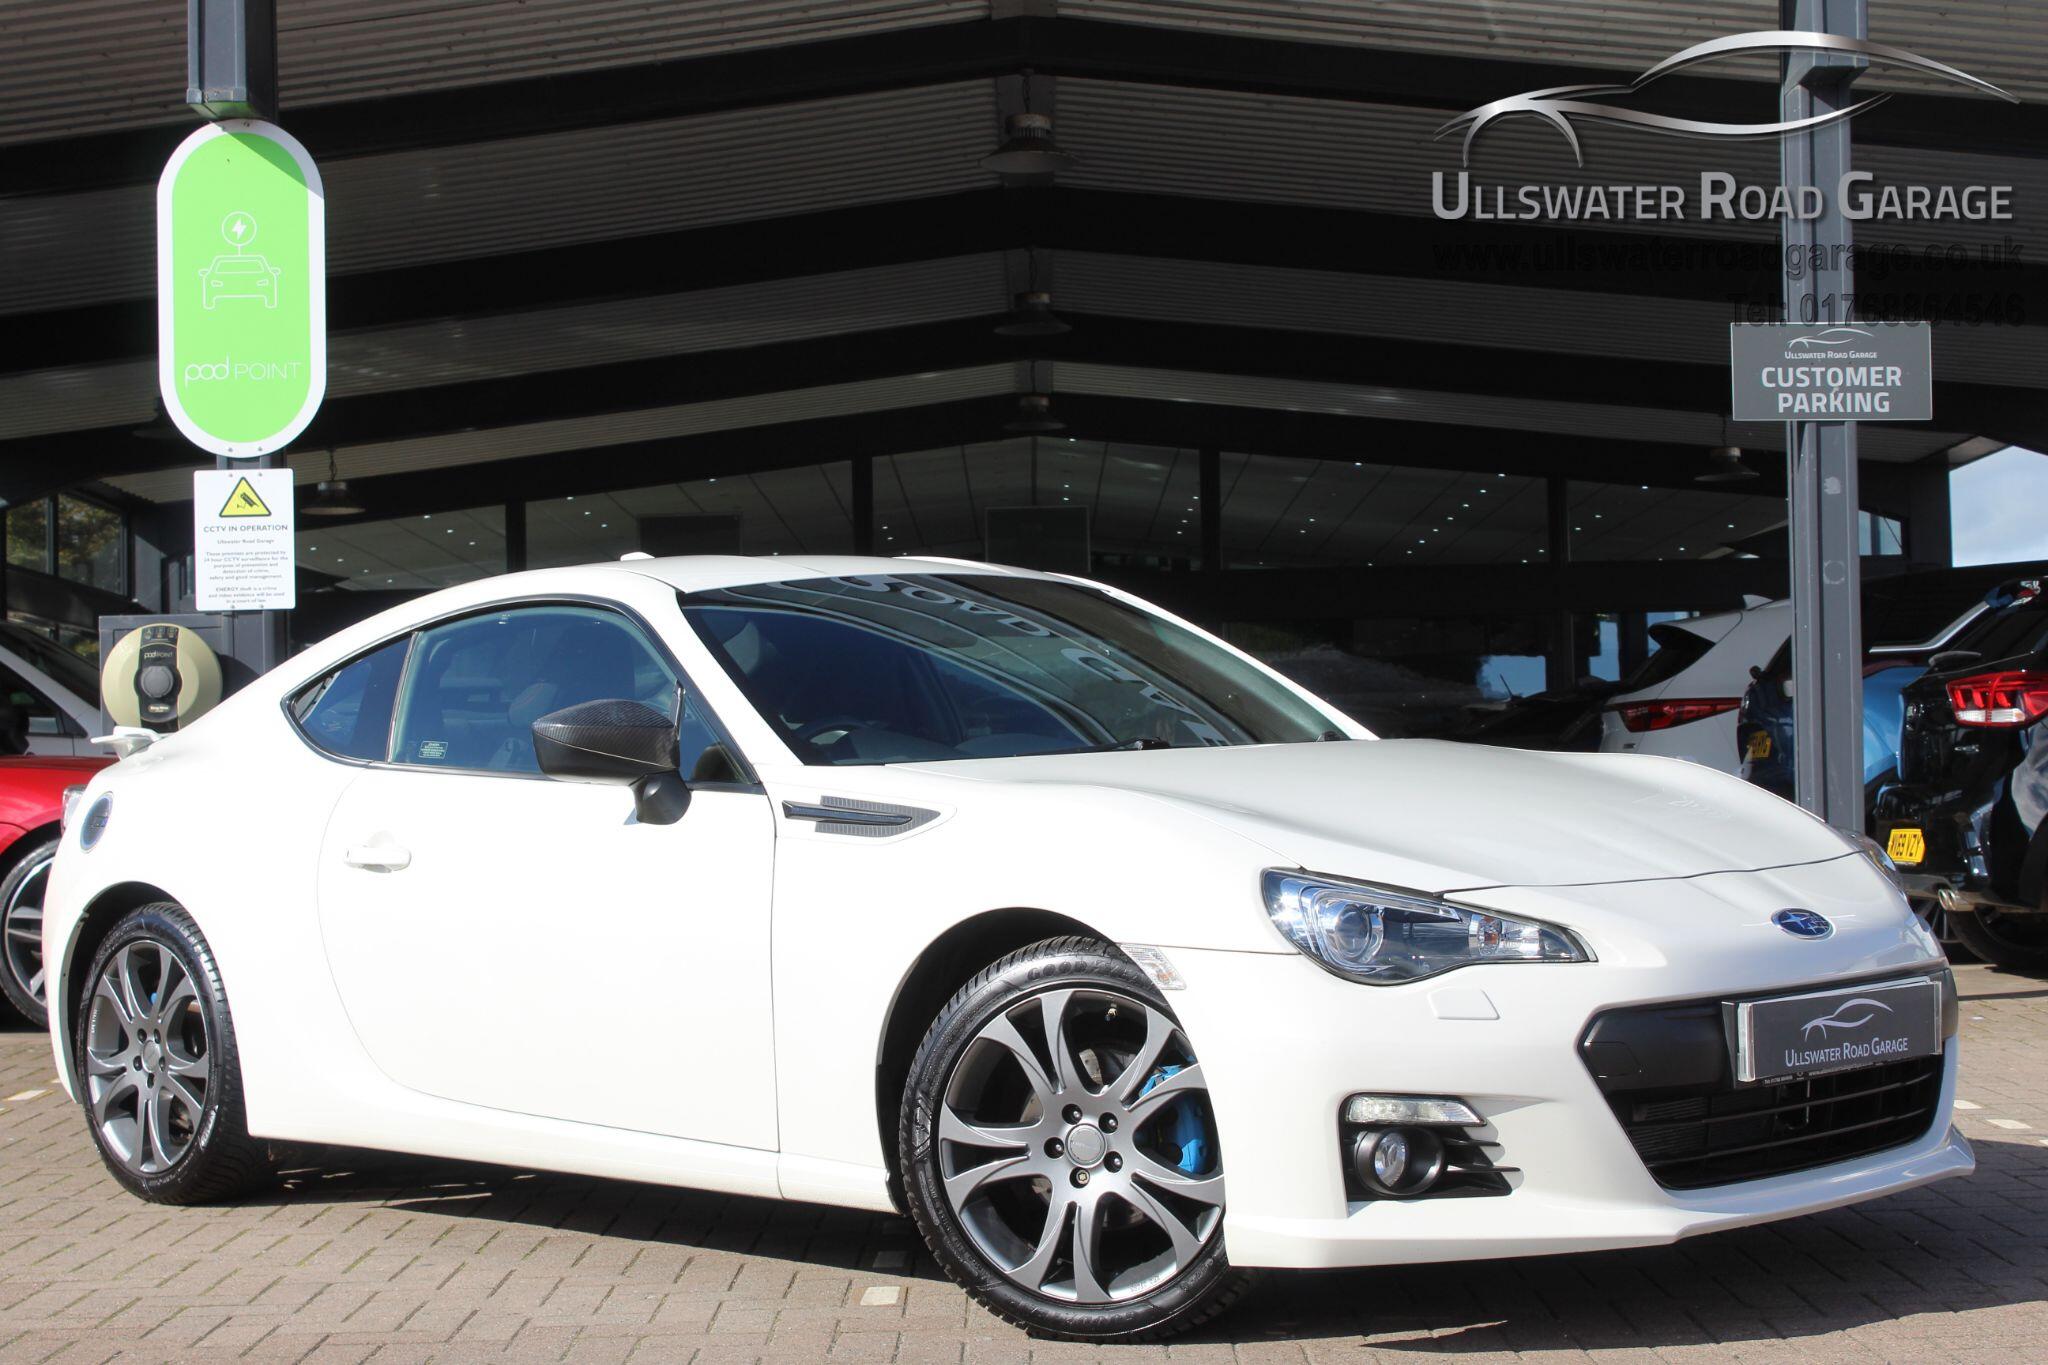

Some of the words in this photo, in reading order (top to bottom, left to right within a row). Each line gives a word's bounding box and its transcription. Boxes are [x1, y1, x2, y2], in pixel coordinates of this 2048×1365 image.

[1784, 351, 1826, 359] ULLSWATER
[1827, 351, 1848, 359] ROAD
[1849, 350, 1878, 359] GARAGE
[185, 354, 229, 389] pod
[235, 361, 301, 380] POINT
[1761, 366, 1902, 388] CUSTOMER
[1778, 392, 1890, 413] PARKING
[240, 524, 288, 532] OPERATION
[1785, 1047, 1841, 1067] ULLSWATER
[1843, 1041, 1870, 1058] ROAD
[1871, 1037, 1909, 1055] GARAGE
